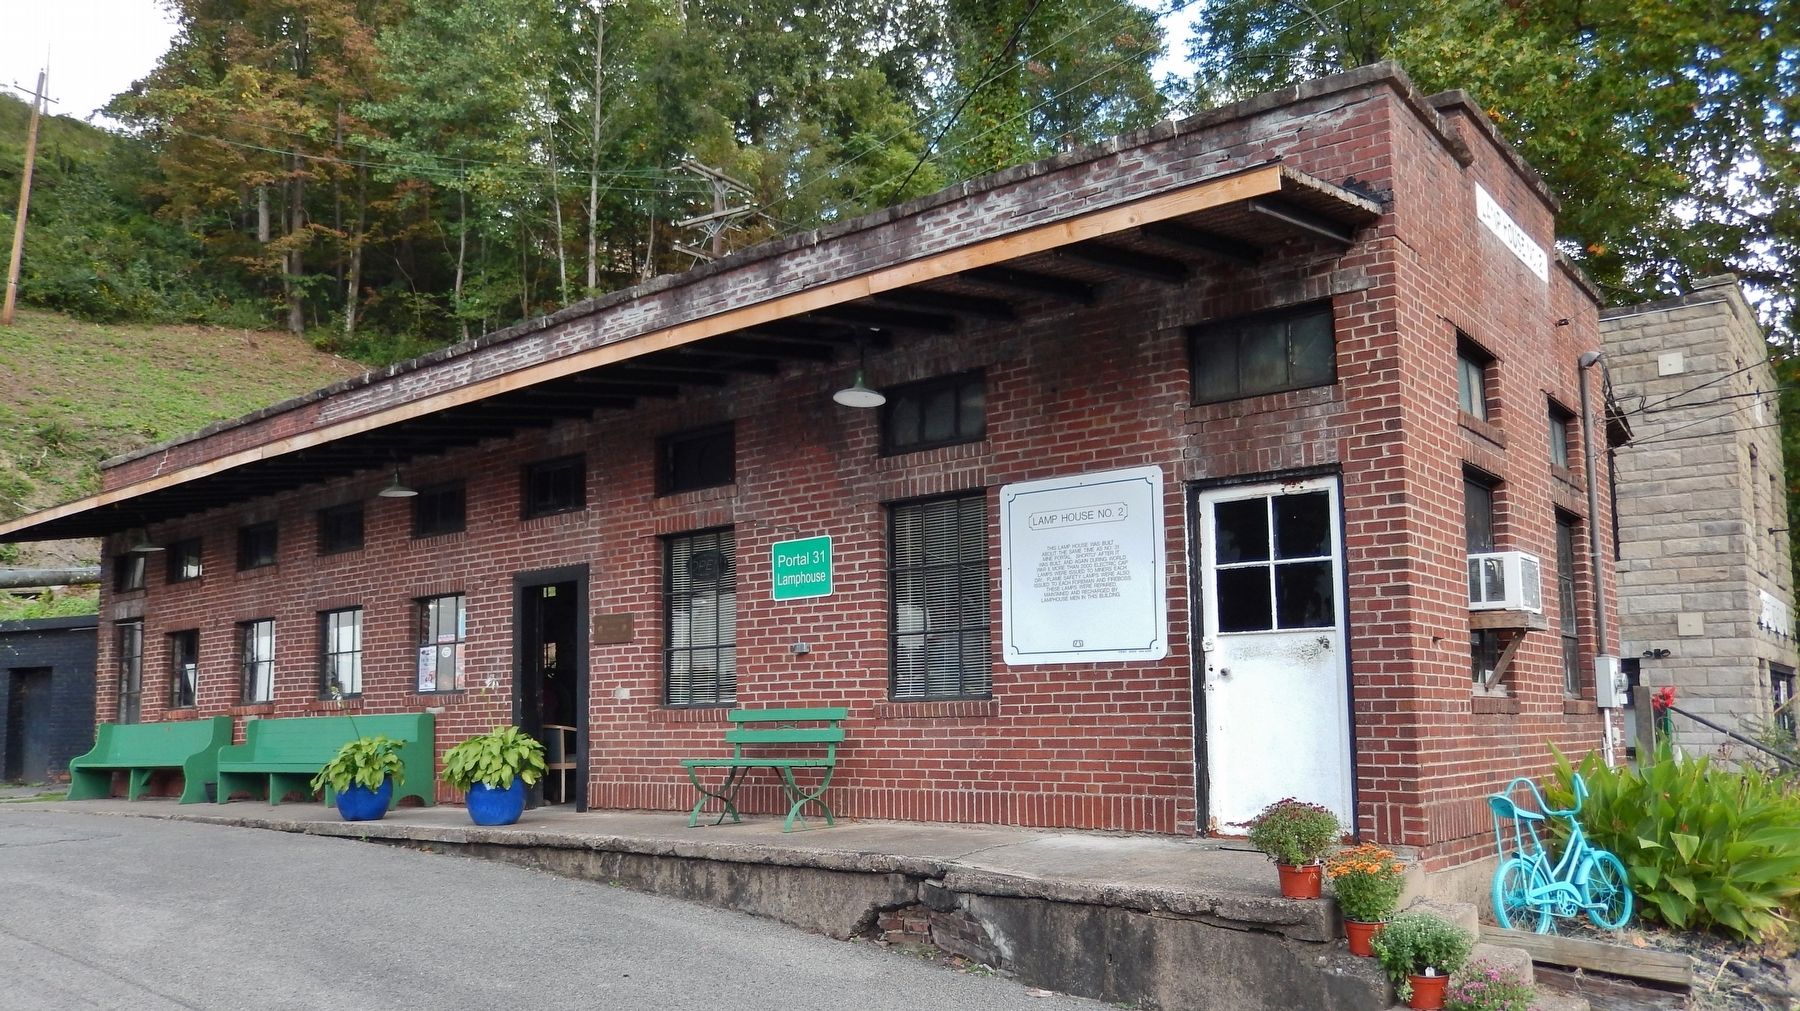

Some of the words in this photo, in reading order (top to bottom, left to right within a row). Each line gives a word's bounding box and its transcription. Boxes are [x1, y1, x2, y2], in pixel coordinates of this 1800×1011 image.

[1033, 515, 1057, 526] LAMP
[1061, 511, 1093, 522] HOUSE
[1098, 508, 1113, 518] NO.
[1118, 507, 1123, 516] 2
[778, 552, 809, 567] Portal
[813, 550, 824, 563] 31
[778, 572, 825, 587] Lamphouse
